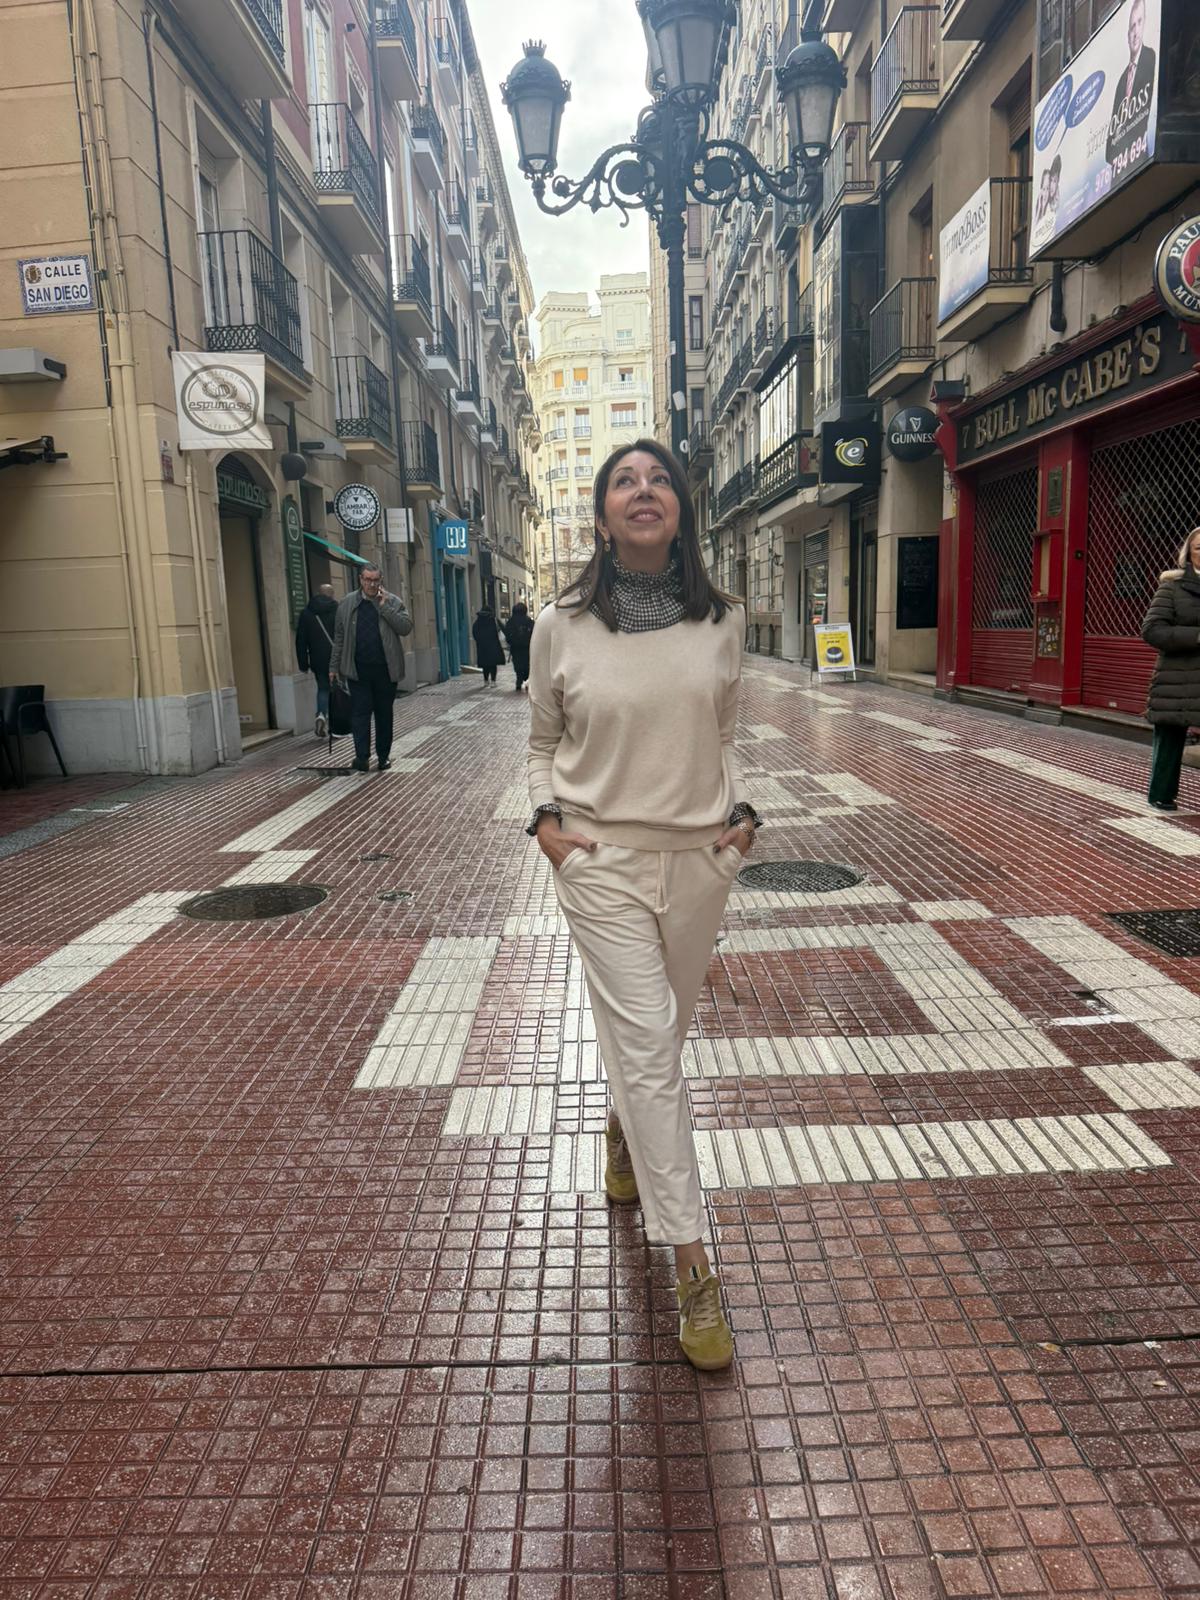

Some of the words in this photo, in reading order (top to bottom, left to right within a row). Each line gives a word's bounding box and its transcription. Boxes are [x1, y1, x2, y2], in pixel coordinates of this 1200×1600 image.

[1111, 148, 1128, 178] 794
[1130, 131, 1148, 163] 694
[44, 264, 82, 278] CALLE
[28, 286, 51, 303] SAN
[54, 284, 88, 301] DIEGO
[974, 399, 1020, 449] BULL
